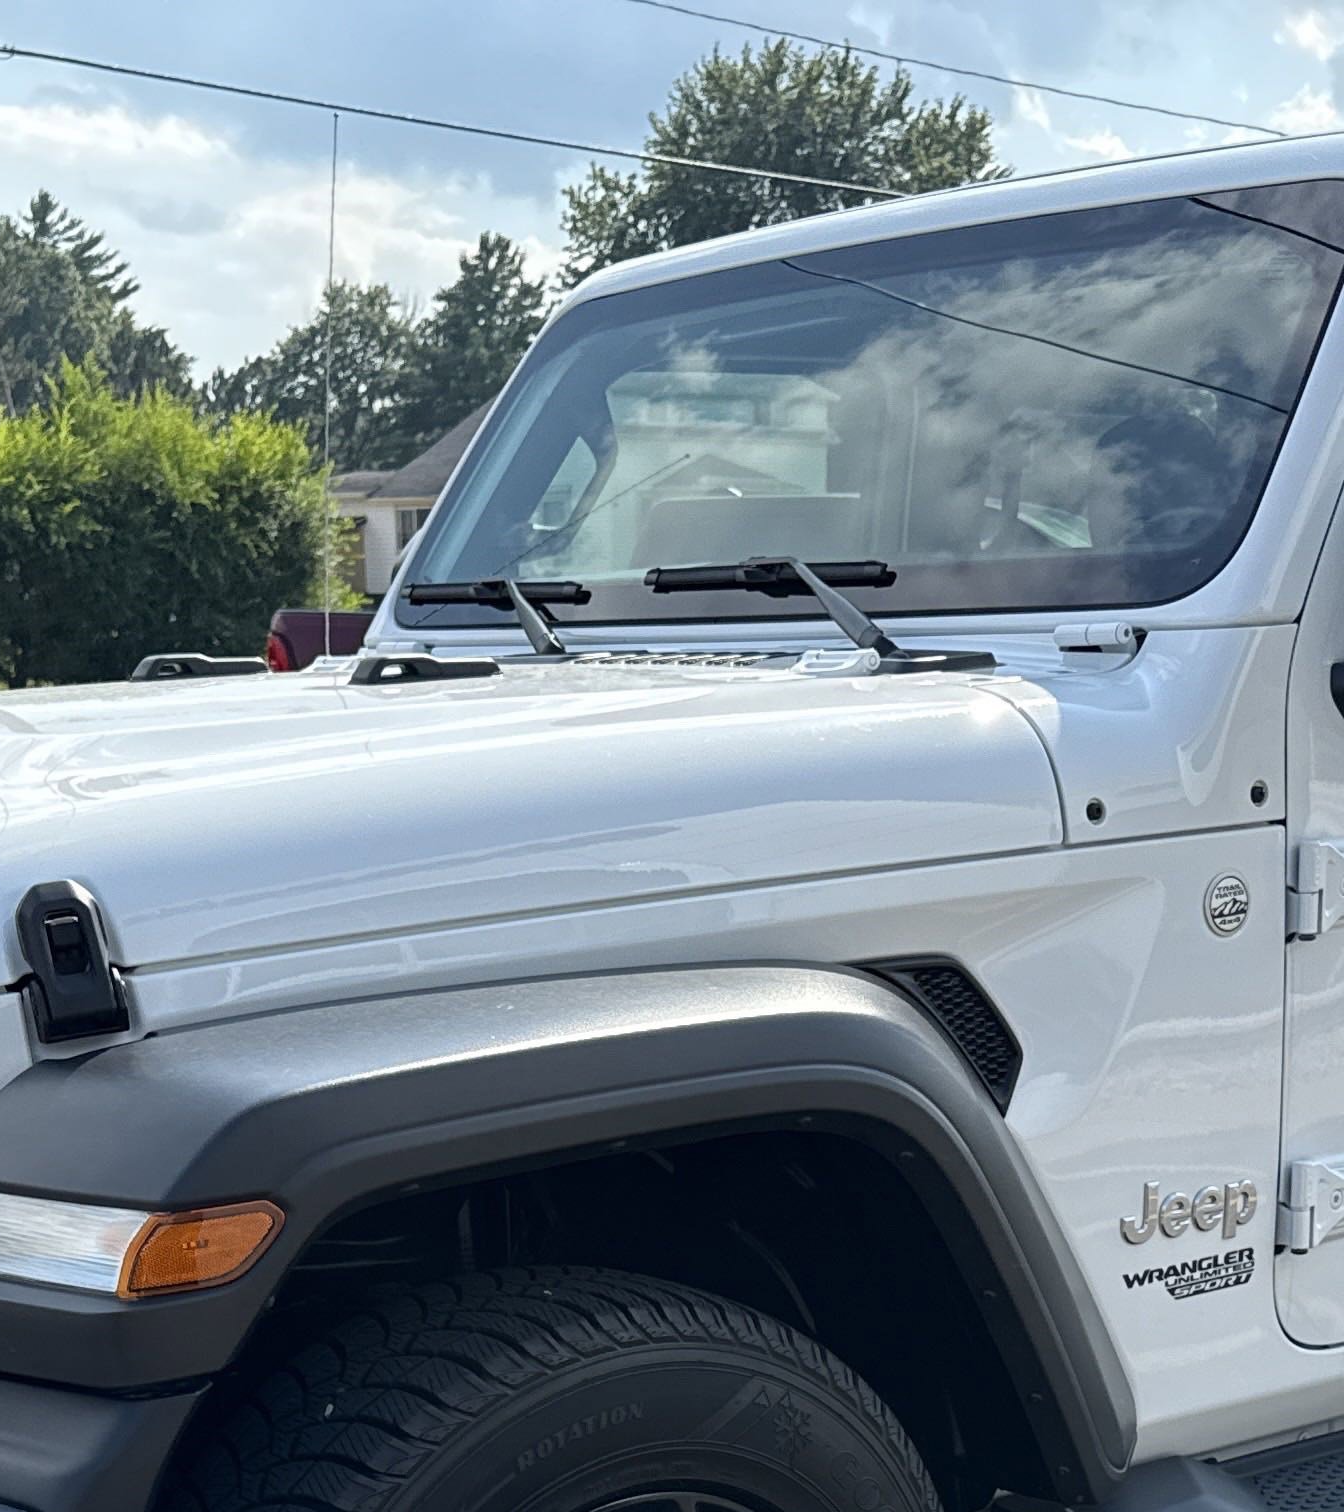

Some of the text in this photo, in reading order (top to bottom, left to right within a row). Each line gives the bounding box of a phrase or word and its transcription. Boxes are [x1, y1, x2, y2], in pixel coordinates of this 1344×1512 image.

[1119, 1178, 1257, 1246] Jeep
[1122, 1247, 1255, 1289] WRANGLER
[1164, 1260, 1256, 1288] UNLIMITED
[1170, 1272, 1253, 1299] SPORT
[517, 1400, 647, 1473] ROTATION
